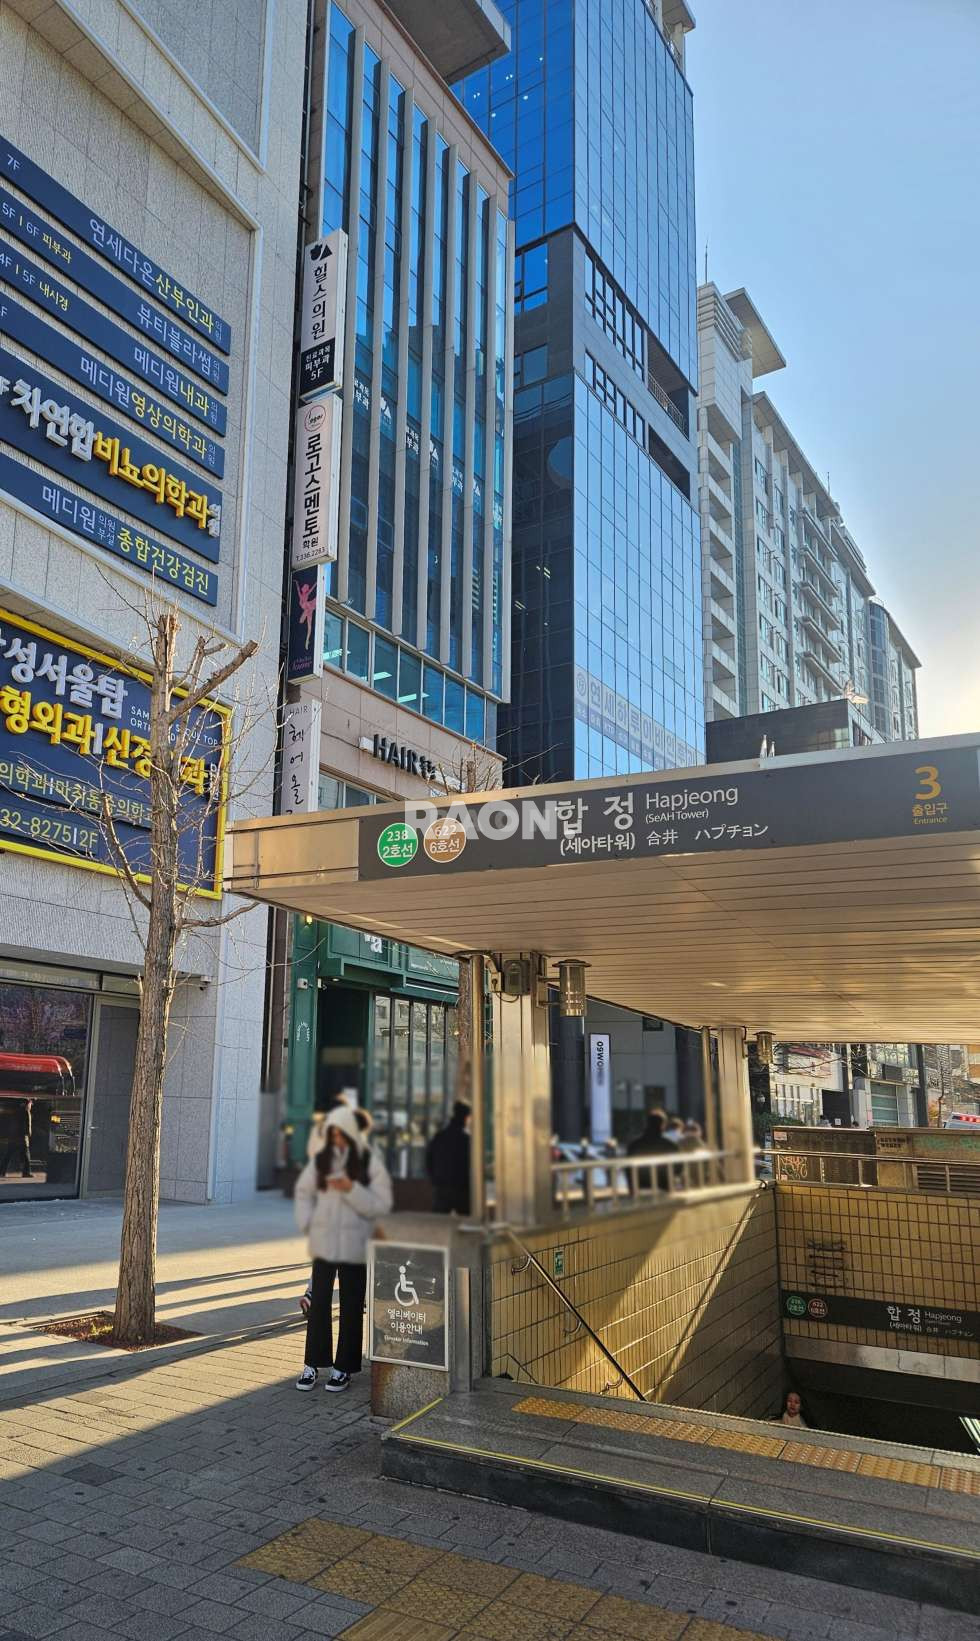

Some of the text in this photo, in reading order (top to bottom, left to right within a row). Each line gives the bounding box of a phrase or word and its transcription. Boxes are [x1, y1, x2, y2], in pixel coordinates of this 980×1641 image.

[7, 154, 21, 171] 7F
[90, 218, 214, 334] 연세다온산부인과
[2, 202, 16, 220] 5F
[26, 222, 40, 238] 6F
[43, 233, 72, 264] 피부과
[137, 304, 212, 376] 뷰티블라썸
[22, 269, 36, 285] 5F
[40, 281, 68, 312] 내시경
[311, 263, 327, 340] 힐스의원
[310, 367, 323, 380] 5F
[303, 433, 322, 538] 로고스멘토
[42, 485, 96, 534] 메디원
[118, 527, 209, 595] 종합건강검진
[373, 734, 417, 775] HAIR
[915, 766, 941, 800] 3
[646, 787, 738, 811] Hapjeong
[913, 803, 949, 817] 출입구
[387, 830, 408, 842] 238
[434, 824, 457, 837] 622
[646, 829, 679, 846] 合井
[695, 824, 769, 840] ハプチョン
[382, 843, 414, 858] 2호선
[429, 839, 460, 854] 6호선
[560, 832, 636, 857] (세아타워)
[388, 1308, 426, 1324] 엘리베이터
[925, 1311, 962, 1323] Hapjeong
[391, 1321, 423, 1335] 이용안내
